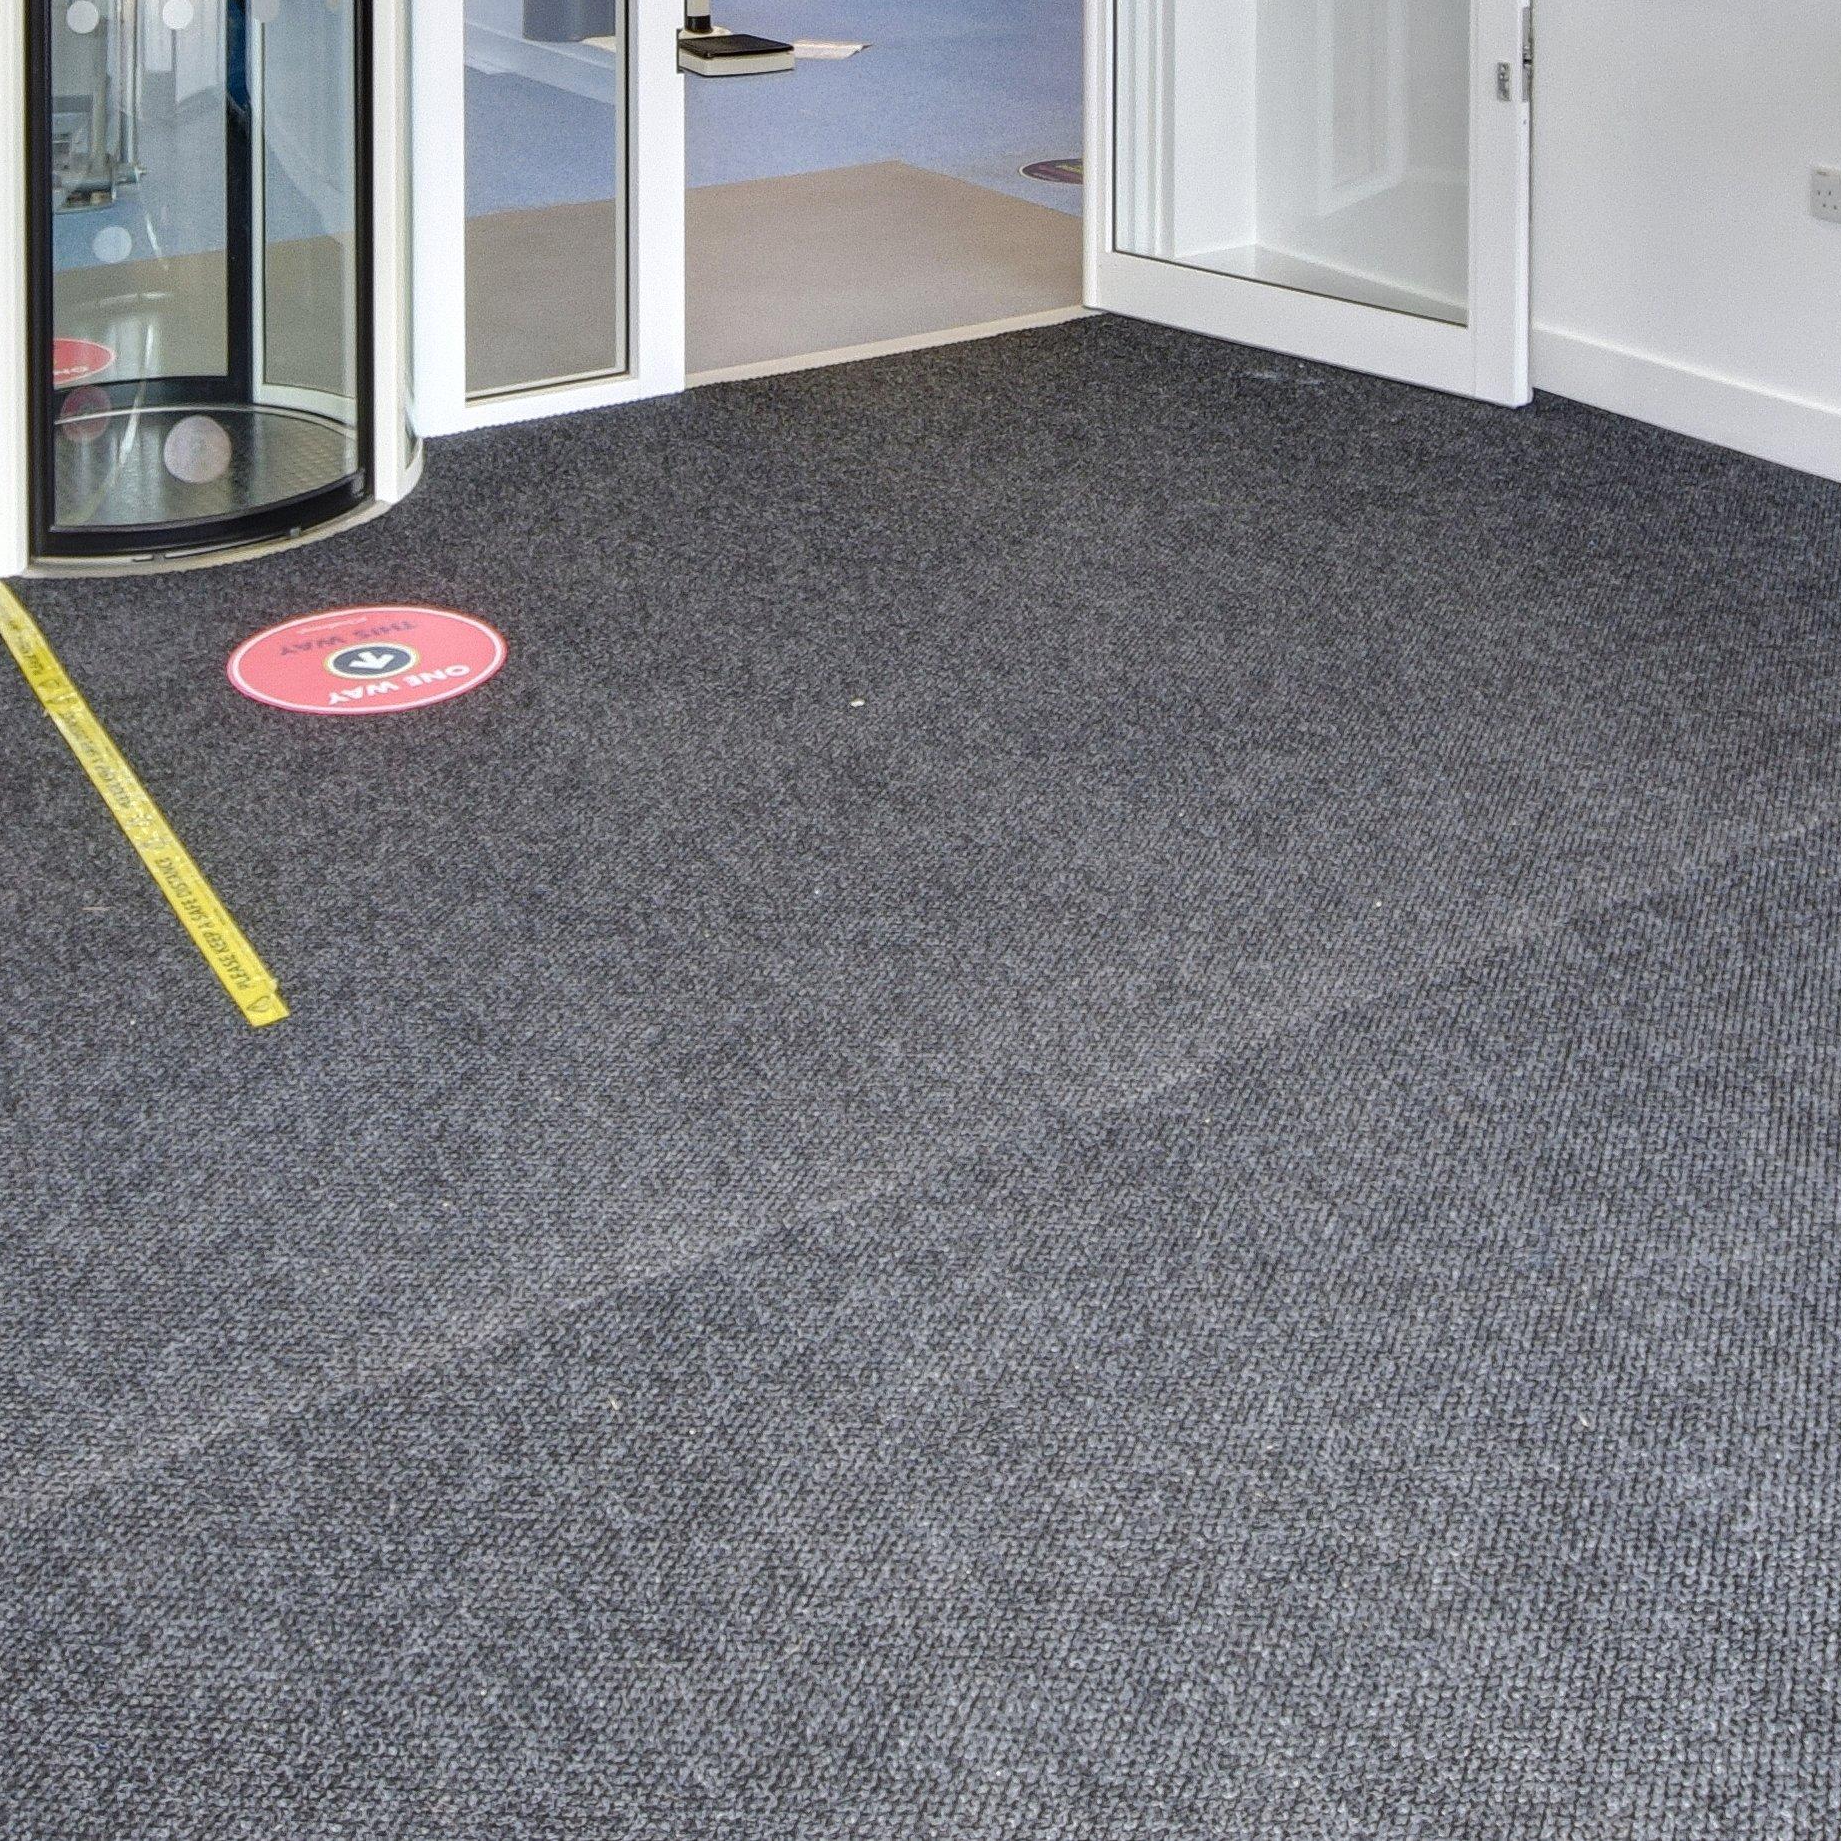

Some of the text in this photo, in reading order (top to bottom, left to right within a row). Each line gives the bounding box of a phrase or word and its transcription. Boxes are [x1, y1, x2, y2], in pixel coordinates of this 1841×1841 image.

[279, 636, 346, 655] WAY
[328, 664, 471, 705] ONE WAY
